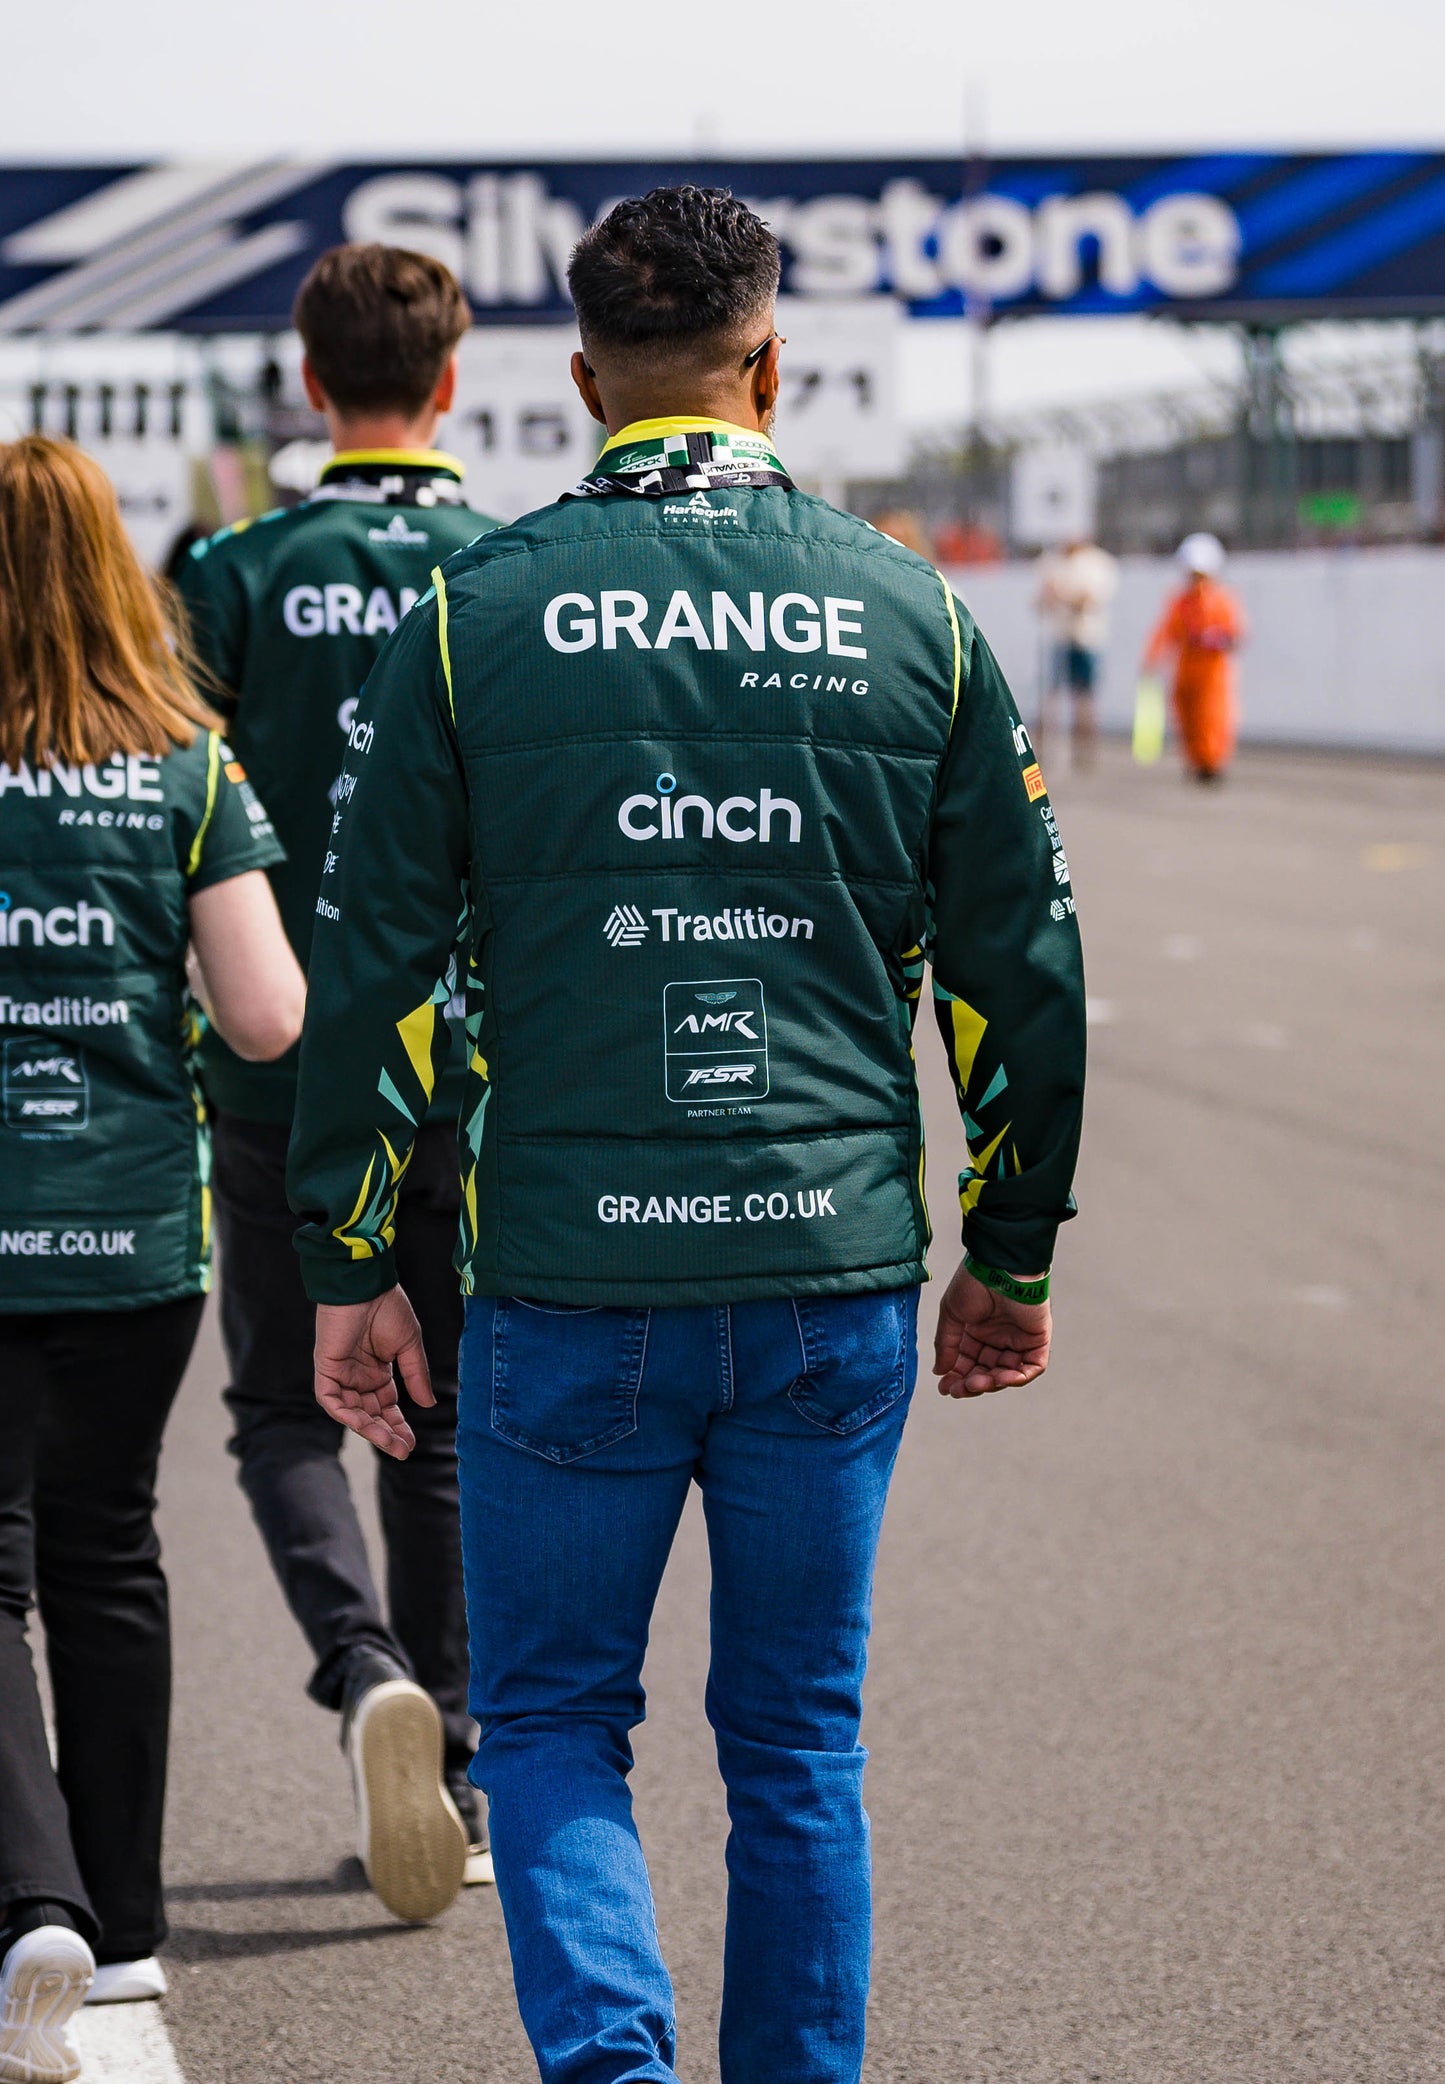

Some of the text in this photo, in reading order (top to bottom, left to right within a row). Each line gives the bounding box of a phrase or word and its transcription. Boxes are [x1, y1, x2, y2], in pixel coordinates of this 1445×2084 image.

[663, 505, 738, 519] Harlequin
[664, 517, 739, 526] TEAMWEAR
[543, 590, 868, 659] GRANGE
[740, 672, 870, 695] RACING
[618, 772, 802, 843] cinch
[58, 809, 165, 831] RACING
[652, 906, 815, 942] Tradition
[673, 1011, 760, 1039] AMR
[11, 1057, 82, 1083] AMR
[687, 1106, 752, 1118] PARTNER TEAM
[597, 1188, 838, 1224] GRANGE.CO.UK
[1014, 1284, 1046, 1299] WALK
